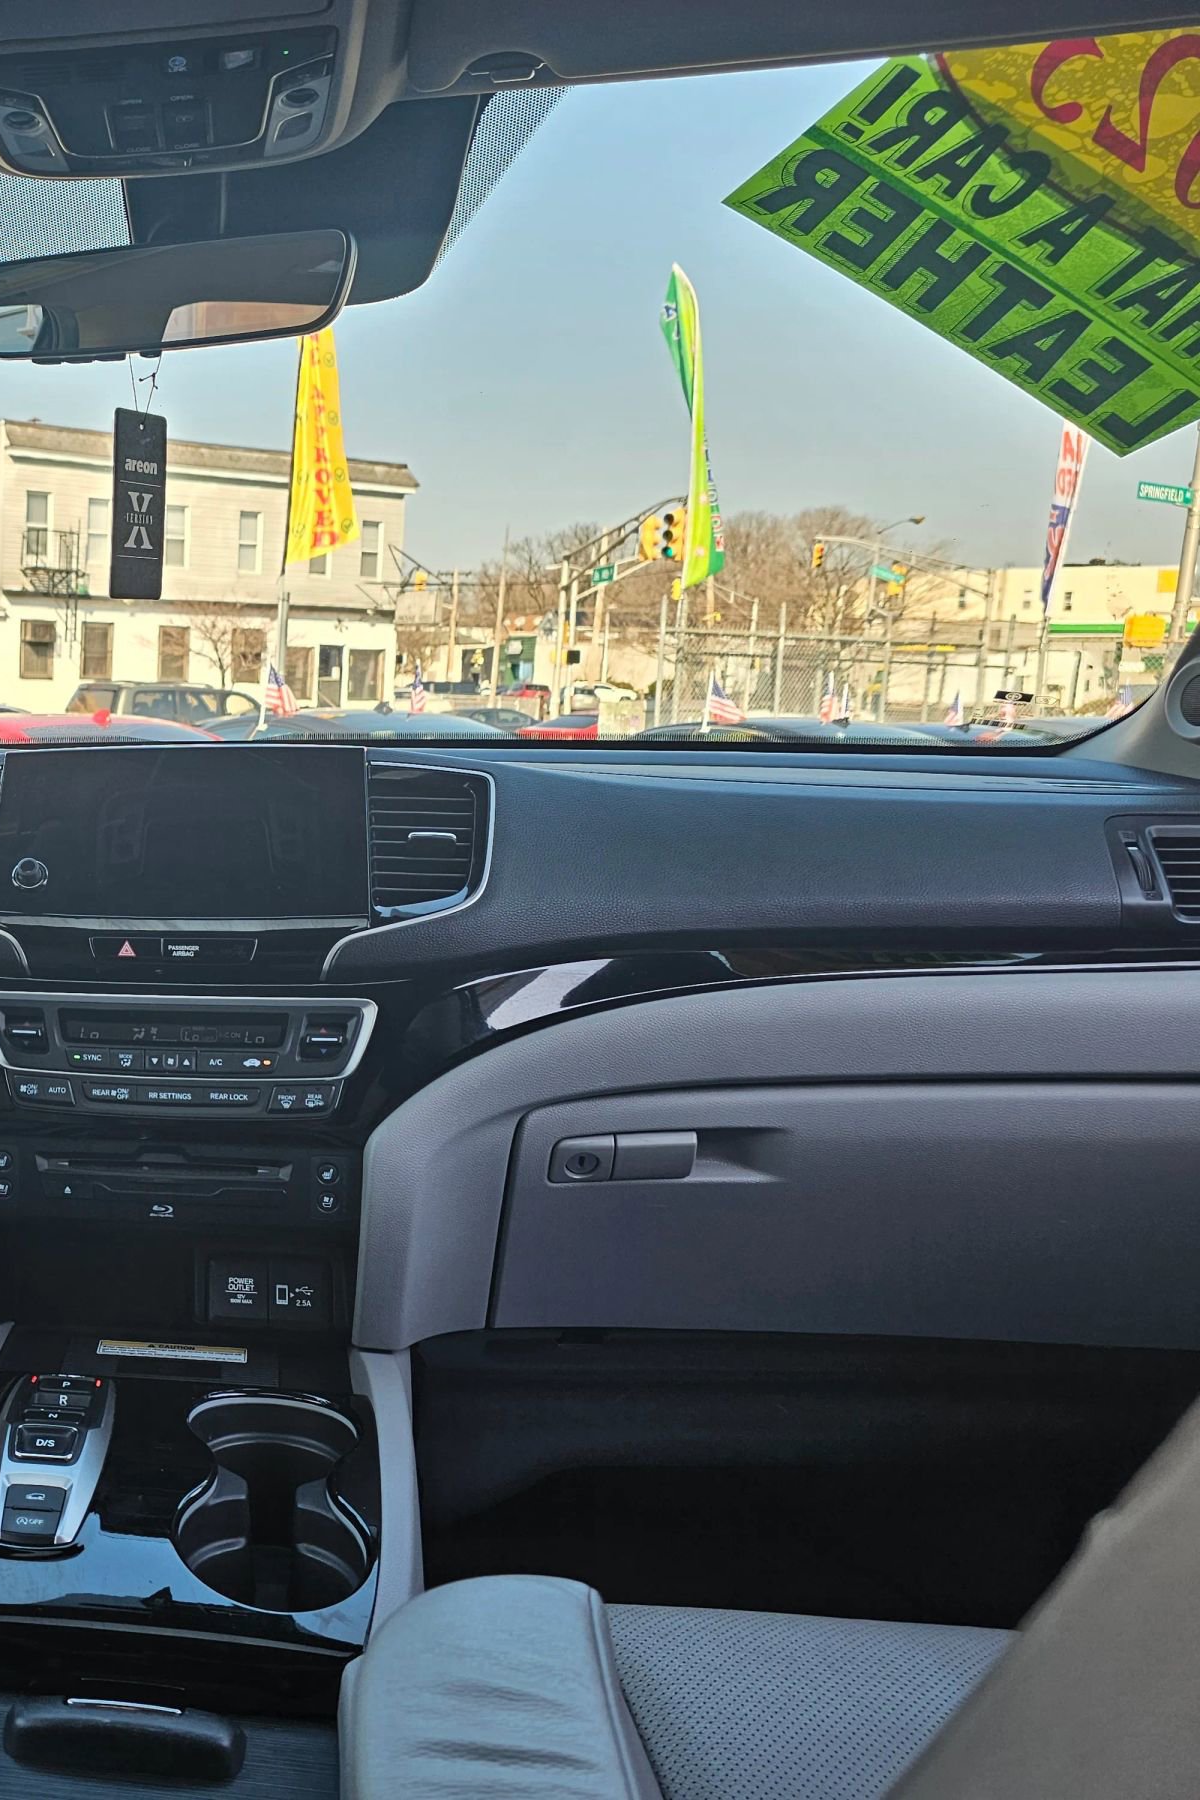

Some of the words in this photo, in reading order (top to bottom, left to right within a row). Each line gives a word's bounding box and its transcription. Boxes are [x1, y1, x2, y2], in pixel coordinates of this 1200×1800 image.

[124, 457, 158, 475] areon
[1138, 483, 1185, 502] SPRINGFIELD
[82, 1053, 102, 1062] SYNC
[209, 1058, 223, 1066] A/C
[92, 1088, 111, 1097] REAR
[159, 1092, 192, 1100] SETTINGS
[209, 1092, 229, 1100] REAR
[229, 1093, 249, 1101] LOCK
[228, 1277, 254, 1285] POWER
[227, 1284, 255, 1292] OUTLET
[295, 1299, 312, 1307] 2.5A
[158, 1343, 196, 1351] CAUTION
[59, 1394, 68, 1406] R
[35, 1438, 55, 1448] D/S
[28, 1518, 45, 1526] OFF
